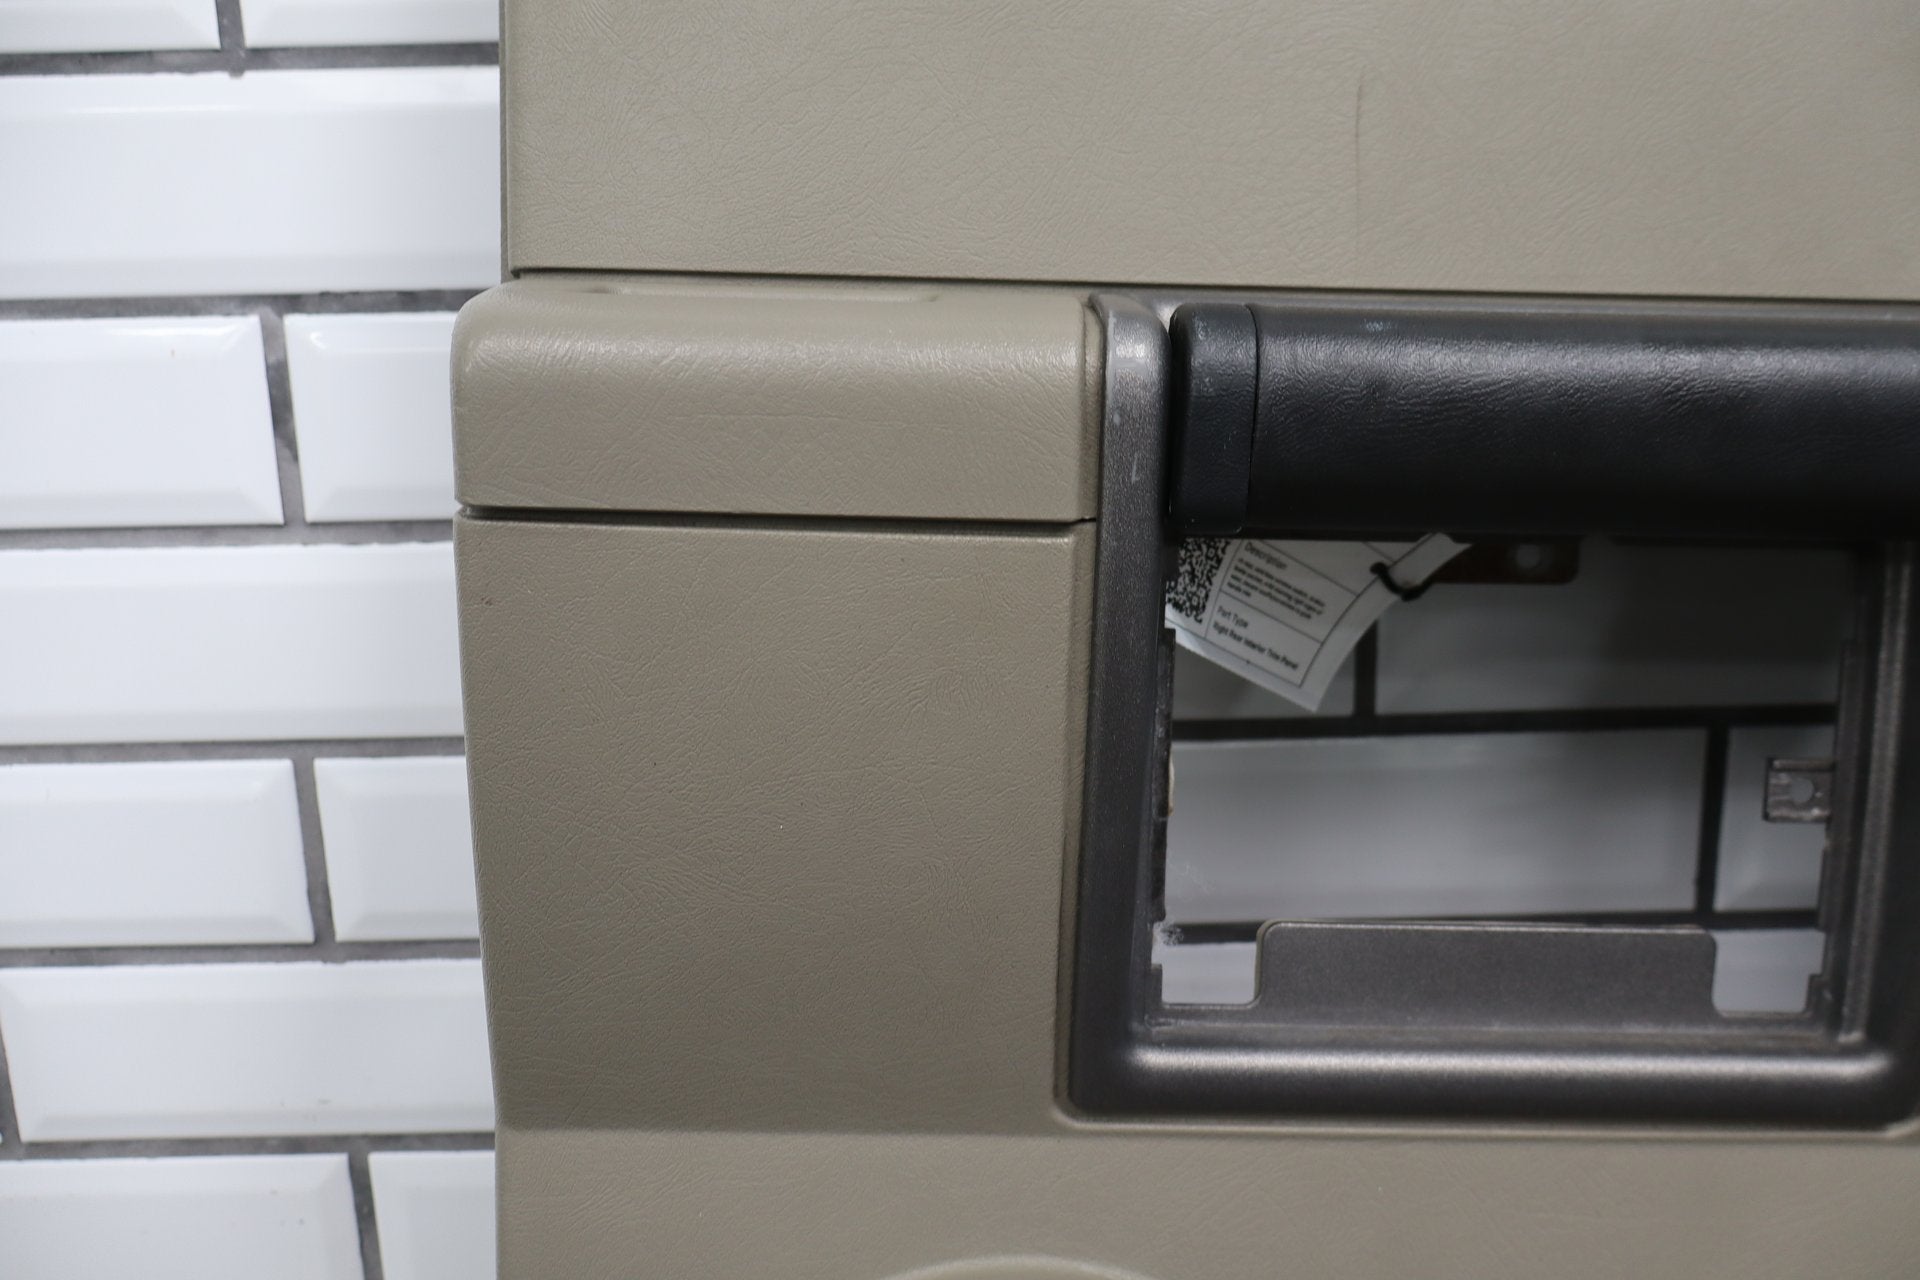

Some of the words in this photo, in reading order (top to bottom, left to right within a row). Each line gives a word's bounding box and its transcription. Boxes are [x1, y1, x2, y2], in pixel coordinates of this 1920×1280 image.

[1244, 541, 1287, 570] Description
[1217, 605, 1231, 620] Part
[1232, 613, 1249, 629] Type
[1212, 621, 1229, 636] Right
[1267, 648, 1281, 661] Trim
[1281, 655, 1299, 671] Panel
